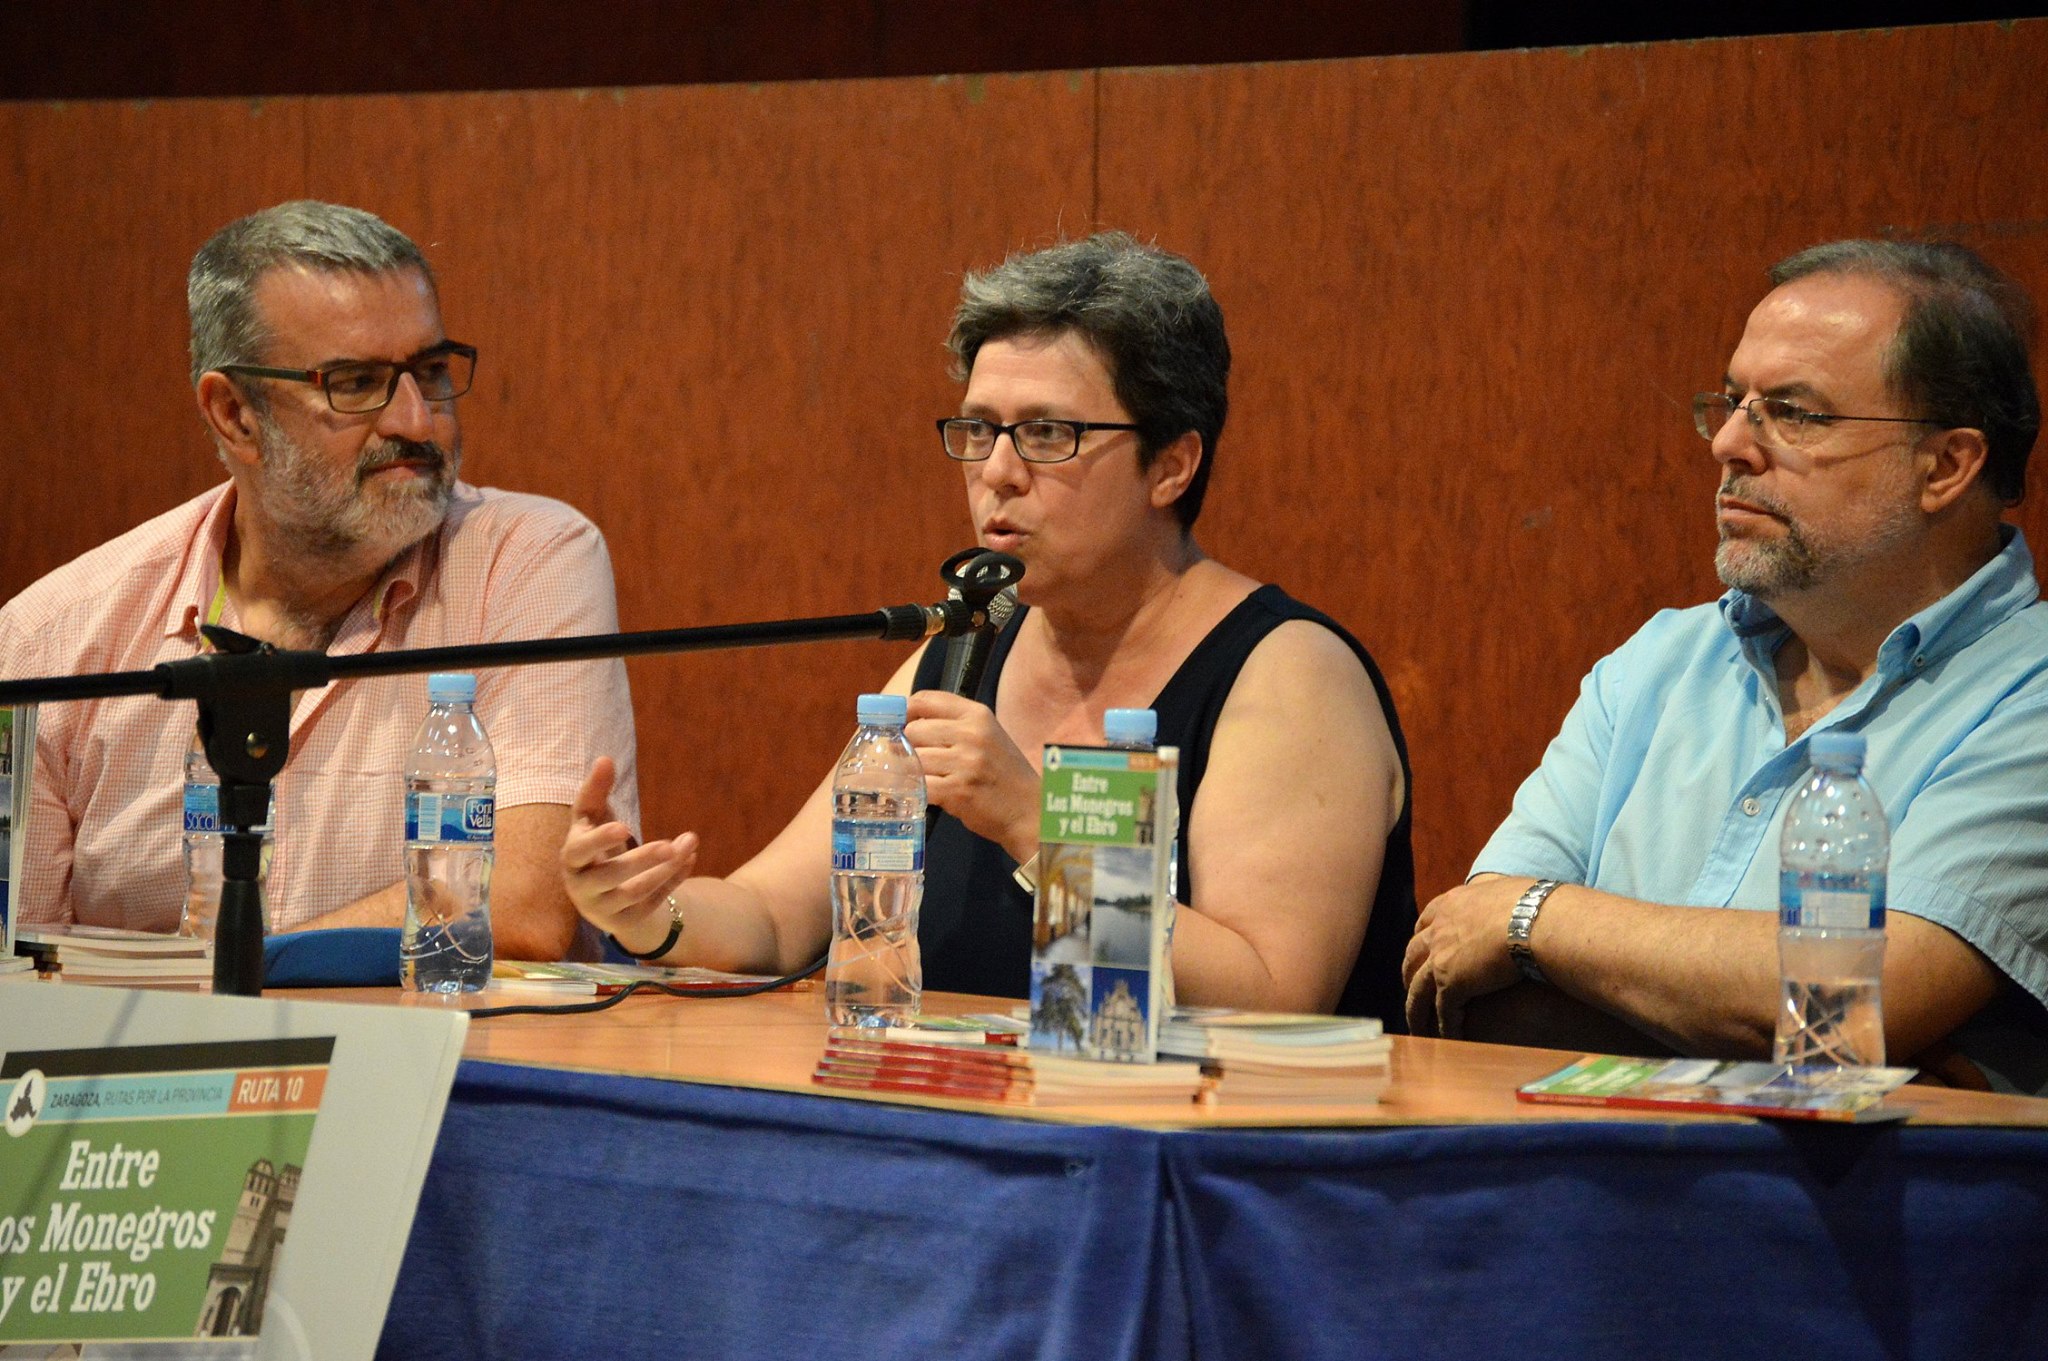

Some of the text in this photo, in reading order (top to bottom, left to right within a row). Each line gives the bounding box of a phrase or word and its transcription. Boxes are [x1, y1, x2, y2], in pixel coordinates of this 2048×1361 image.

[1071, 772, 1109, 793] Entre
[1058, 817, 1069, 837] y
[237, 1076, 304, 1104] RUTA 10
[60, 1140, 160, 1190] Entre
[0, 1202, 216, 1262] os Monegros
[0, 1262, 156, 1324] y el Ebro
